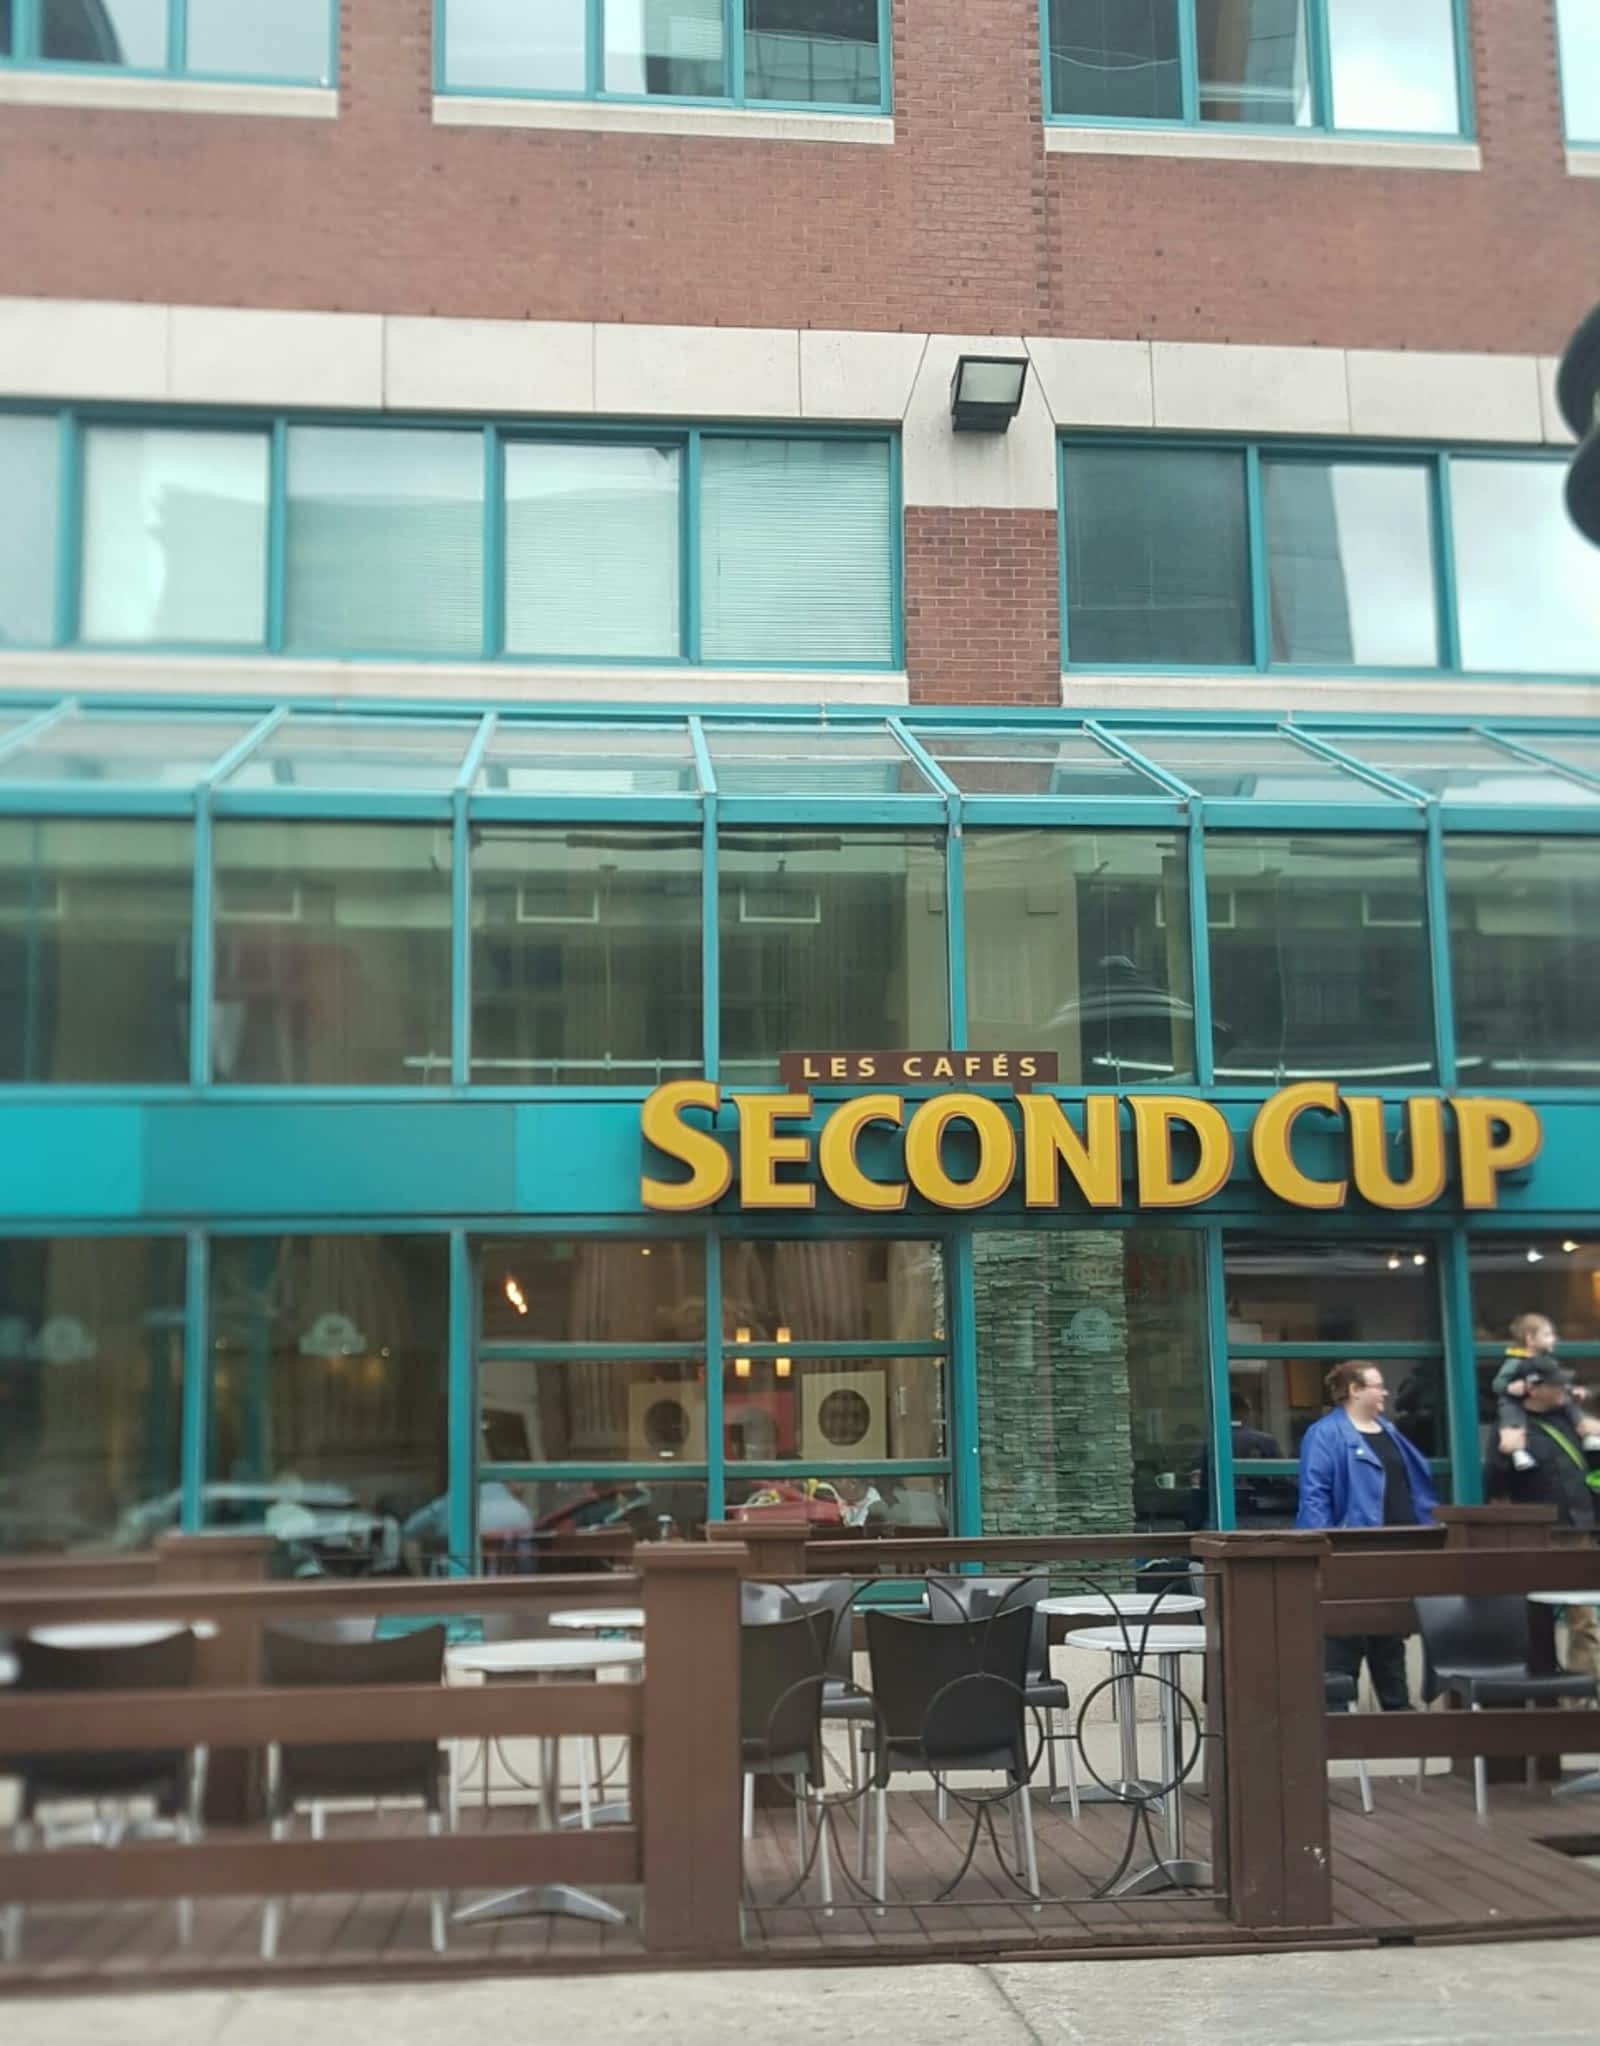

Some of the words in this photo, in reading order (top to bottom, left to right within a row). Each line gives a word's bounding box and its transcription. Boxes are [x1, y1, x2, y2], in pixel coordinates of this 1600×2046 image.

[802, 1057, 876, 1078] LES
[903, 1054, 1037, 1077] CAFÉS
[641, 1080, 1234, 1211] SECOND
[1252, 1081, 1541, 1209] CUP
